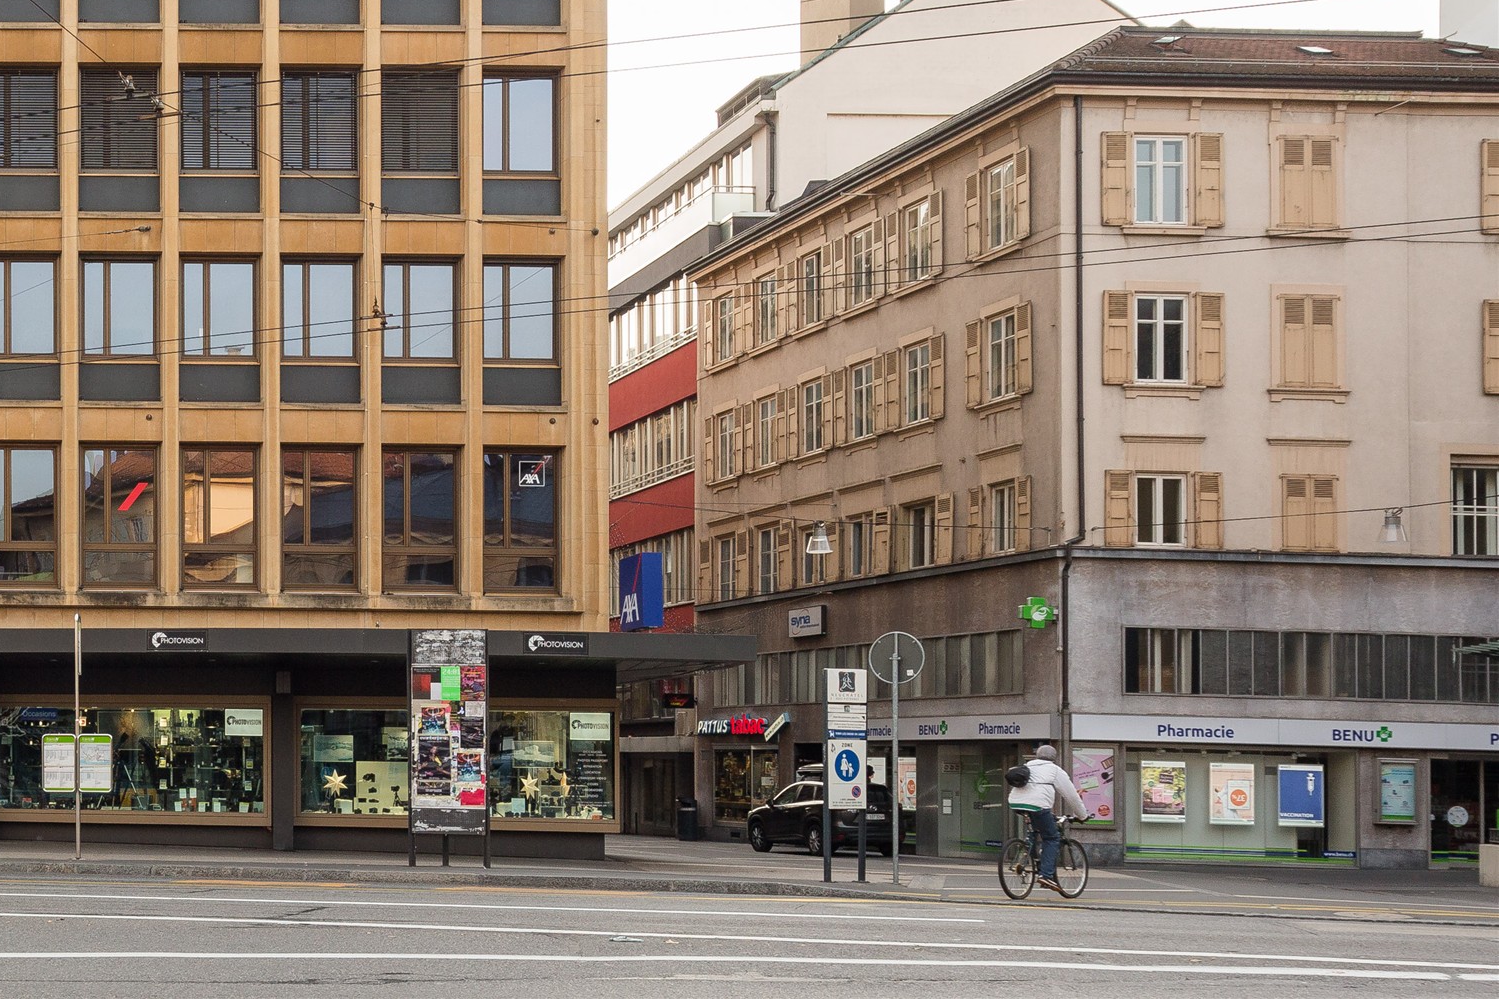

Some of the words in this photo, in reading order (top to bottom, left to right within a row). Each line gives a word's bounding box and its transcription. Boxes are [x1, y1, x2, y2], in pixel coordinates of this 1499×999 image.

[519, 473, 540, 484] AXA
[619, 592, 640, 625] AXA
[790, 615, 811, 628] syna
[22, 710, 57, 718] Occasions
[697, 720, 728, 734] PATTUS
[730, 713, 765, 735] tabac
[918, 724, 940, 736] BENU
[978, 722, 1021, 735] Pharmacie
[1157, 724, 1235, 739] Pharmacie
[1332, 729, 1374, 742] BENU
